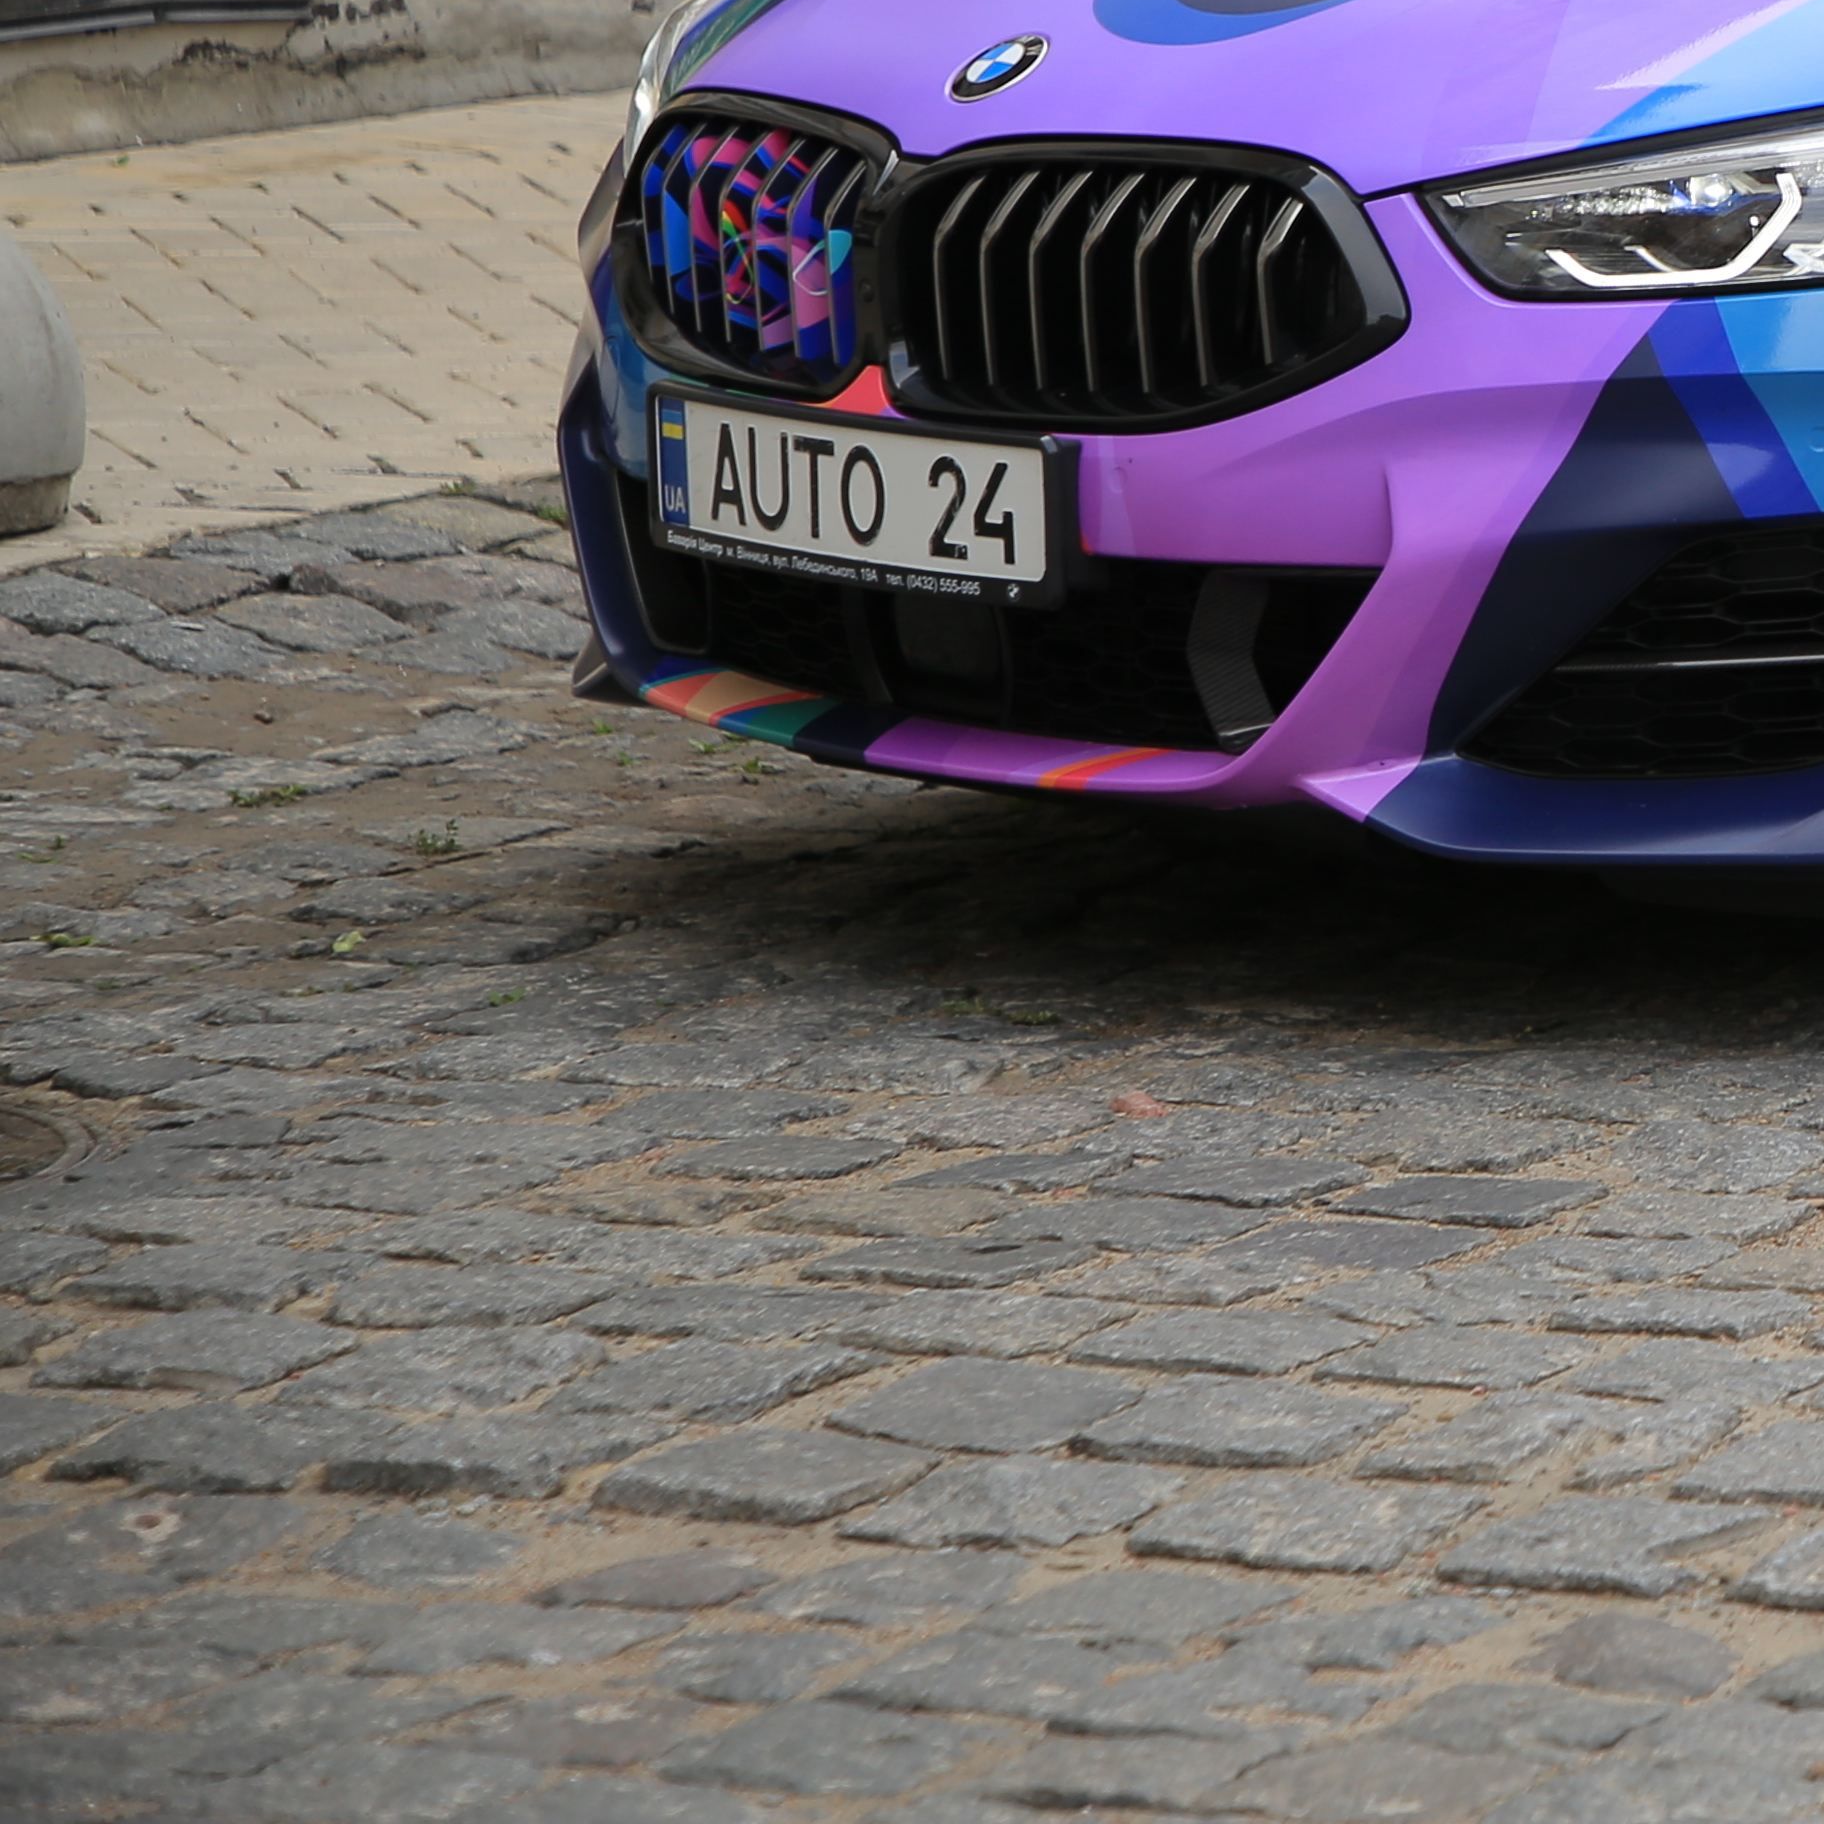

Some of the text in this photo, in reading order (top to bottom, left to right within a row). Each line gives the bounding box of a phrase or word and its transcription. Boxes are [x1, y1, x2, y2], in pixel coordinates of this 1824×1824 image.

[664, 484, 687, 515] UA
[710, 422, 1016, 566] AUTO 24
